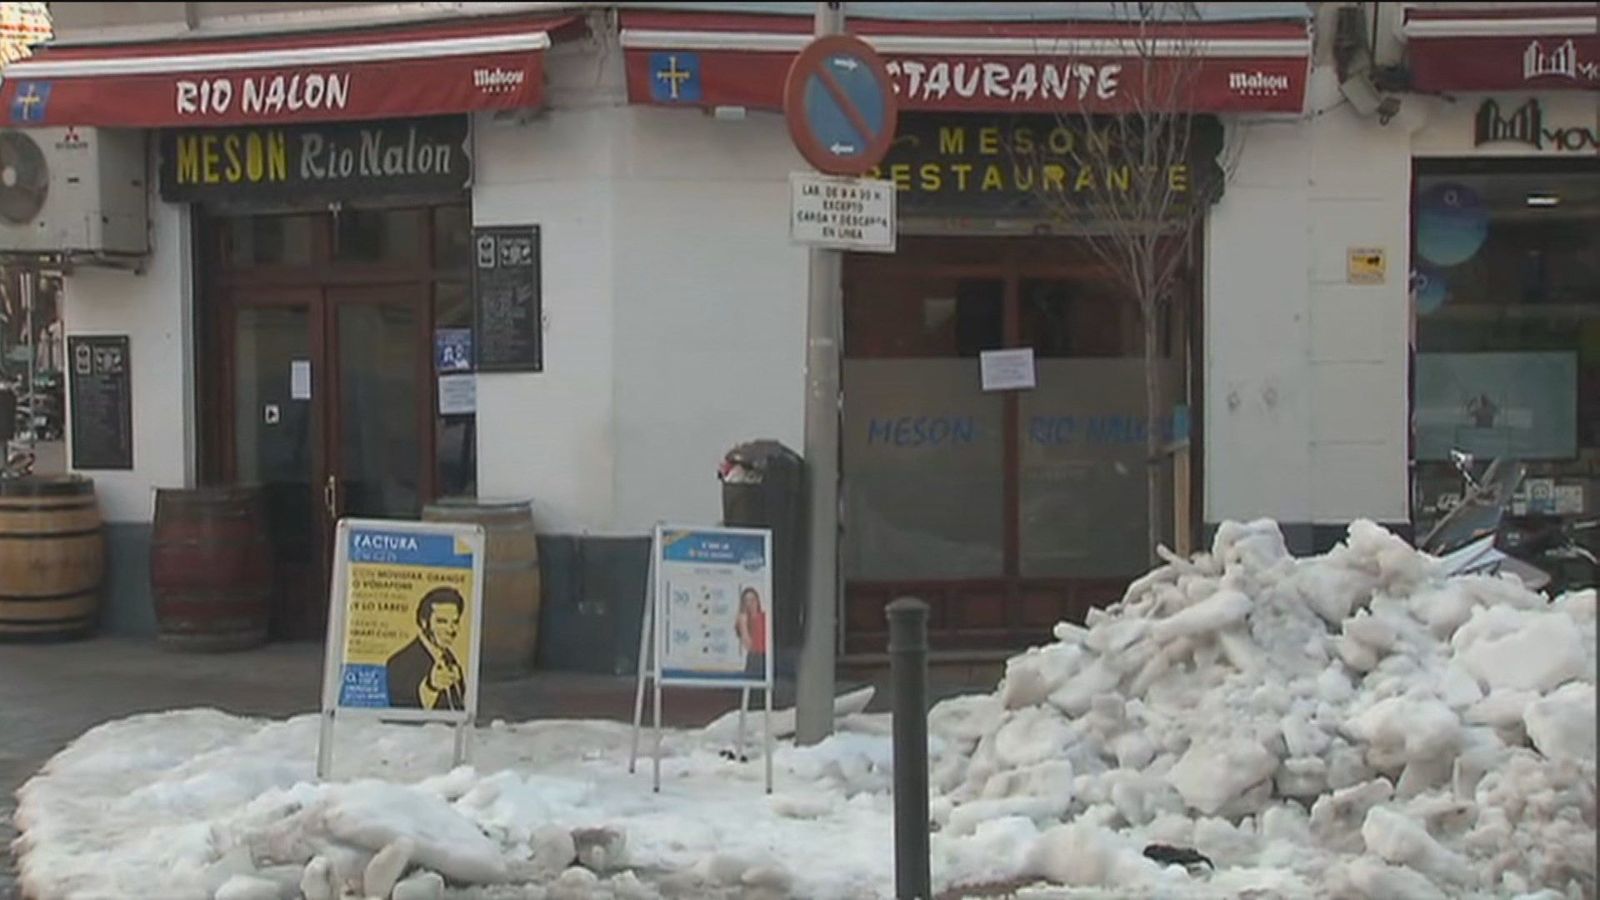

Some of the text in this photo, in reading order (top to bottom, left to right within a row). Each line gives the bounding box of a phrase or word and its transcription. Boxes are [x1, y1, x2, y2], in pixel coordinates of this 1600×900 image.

[176, 73, 350, 115] RIO NALON
[1229, 71, 1288, 89] Mahou
[939, 127, 1109, 155] MESON
[176, 131, 287, 184] MESON
[300, 133, 354, 180] Rio
[865, 164, 1188, 191] ESTAURANE
[868, 415, 975, 446] MESON
[354, 534, 418, 551] FACTURA
